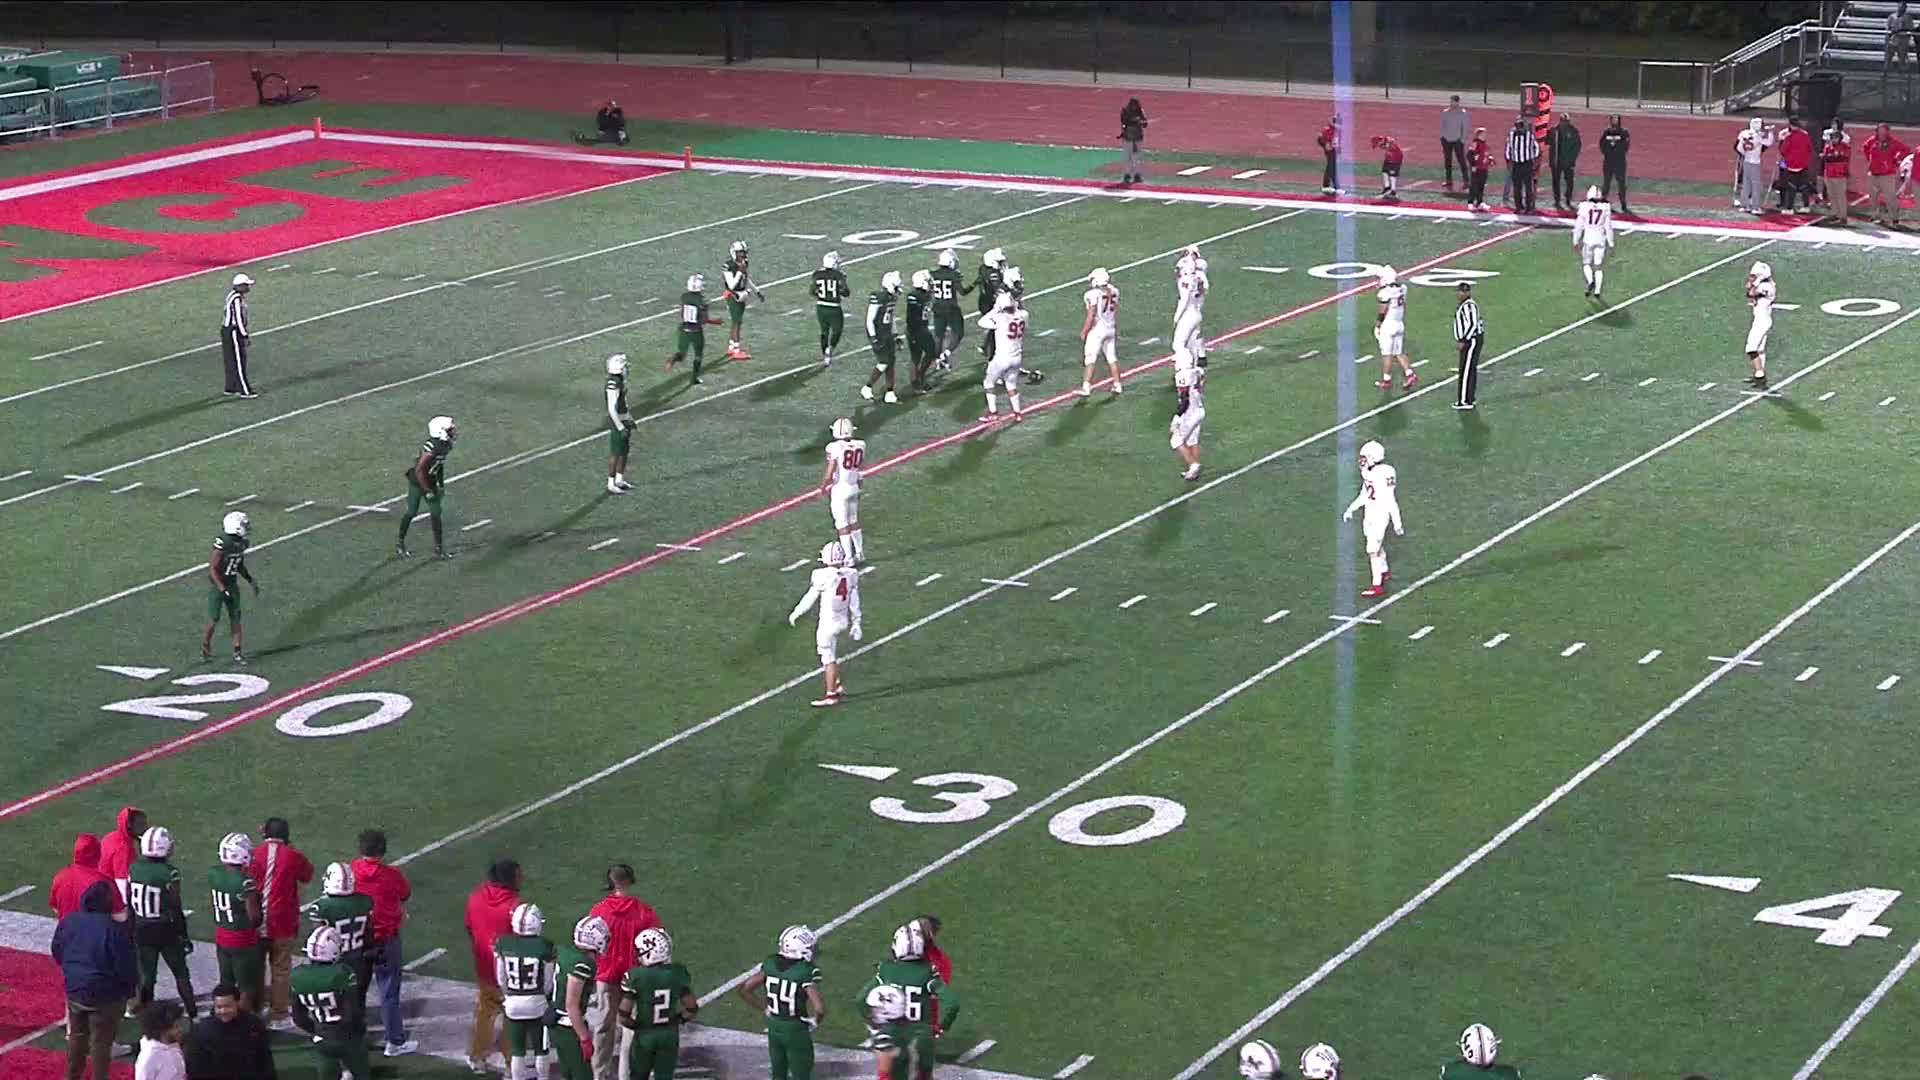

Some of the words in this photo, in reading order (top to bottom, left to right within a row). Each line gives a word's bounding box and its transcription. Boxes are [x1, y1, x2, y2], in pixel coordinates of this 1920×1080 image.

[1588, 209, 1603, 224] 17
[816, 279, 838, 298] 34
[1007, 321, 1026, 340] 93
[843, 449, 863, 469] 80
[835, 577, 849, 601] 4
[130, 882, 161, 918] 80
[211, 889, 234, 922] 14
[1752, 887, 1903, 946] 4
[335, 915, 368, 952] 52
[505, 956, 540, 990] 83
[298, 991, 342, 1023] 42
[653, 988, 671, 1024] 2
[765, 975, 797, 1016] 54
